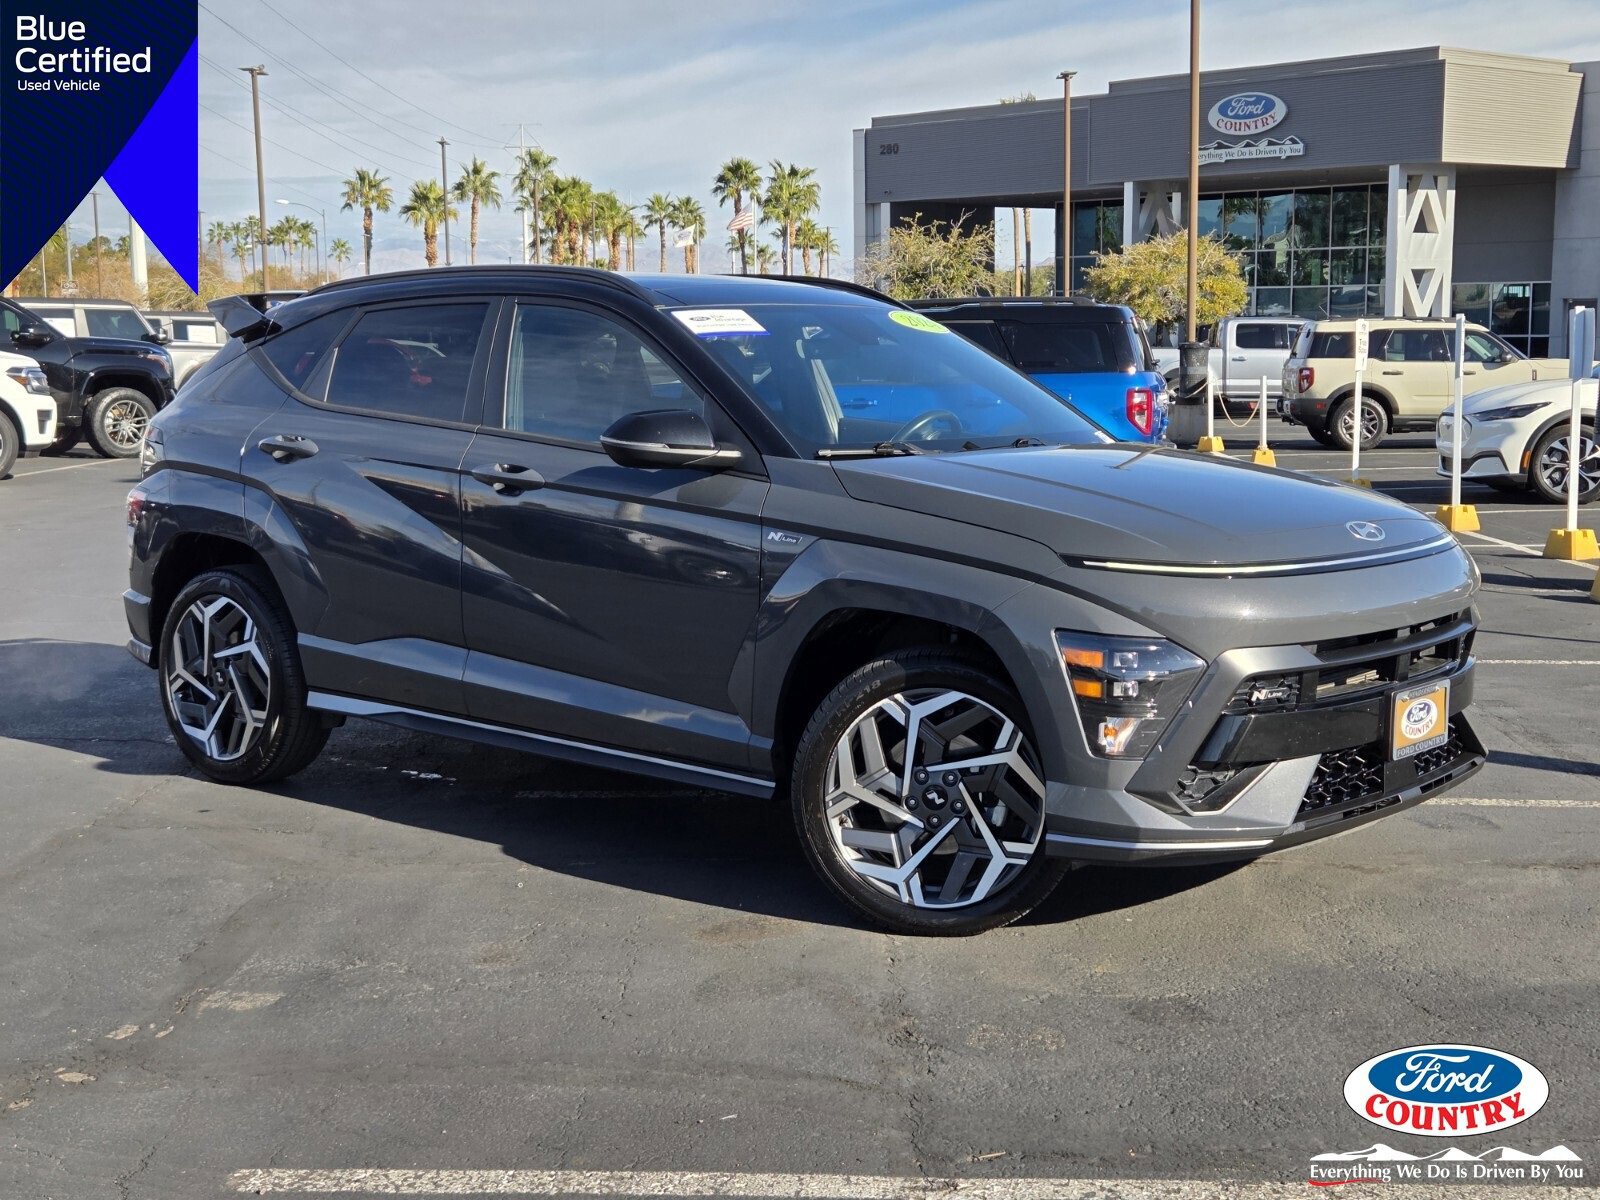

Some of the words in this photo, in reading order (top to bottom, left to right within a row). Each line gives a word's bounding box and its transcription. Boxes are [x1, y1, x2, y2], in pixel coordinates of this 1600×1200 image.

[1227, 96, 1265, 116] Ford
[1216, 112, 1278, 132] COUNTRY
[1198, 151, 1223, 161] erything
[1256, 148, 1276, 156] Driven
[1279, 147, 1287, 156] By
[1405, 717, 1433, 736] COUNTRY
[1397, 745, 1415, 758] FORD
[1415, 736, 1446, 752] COUNTRY
